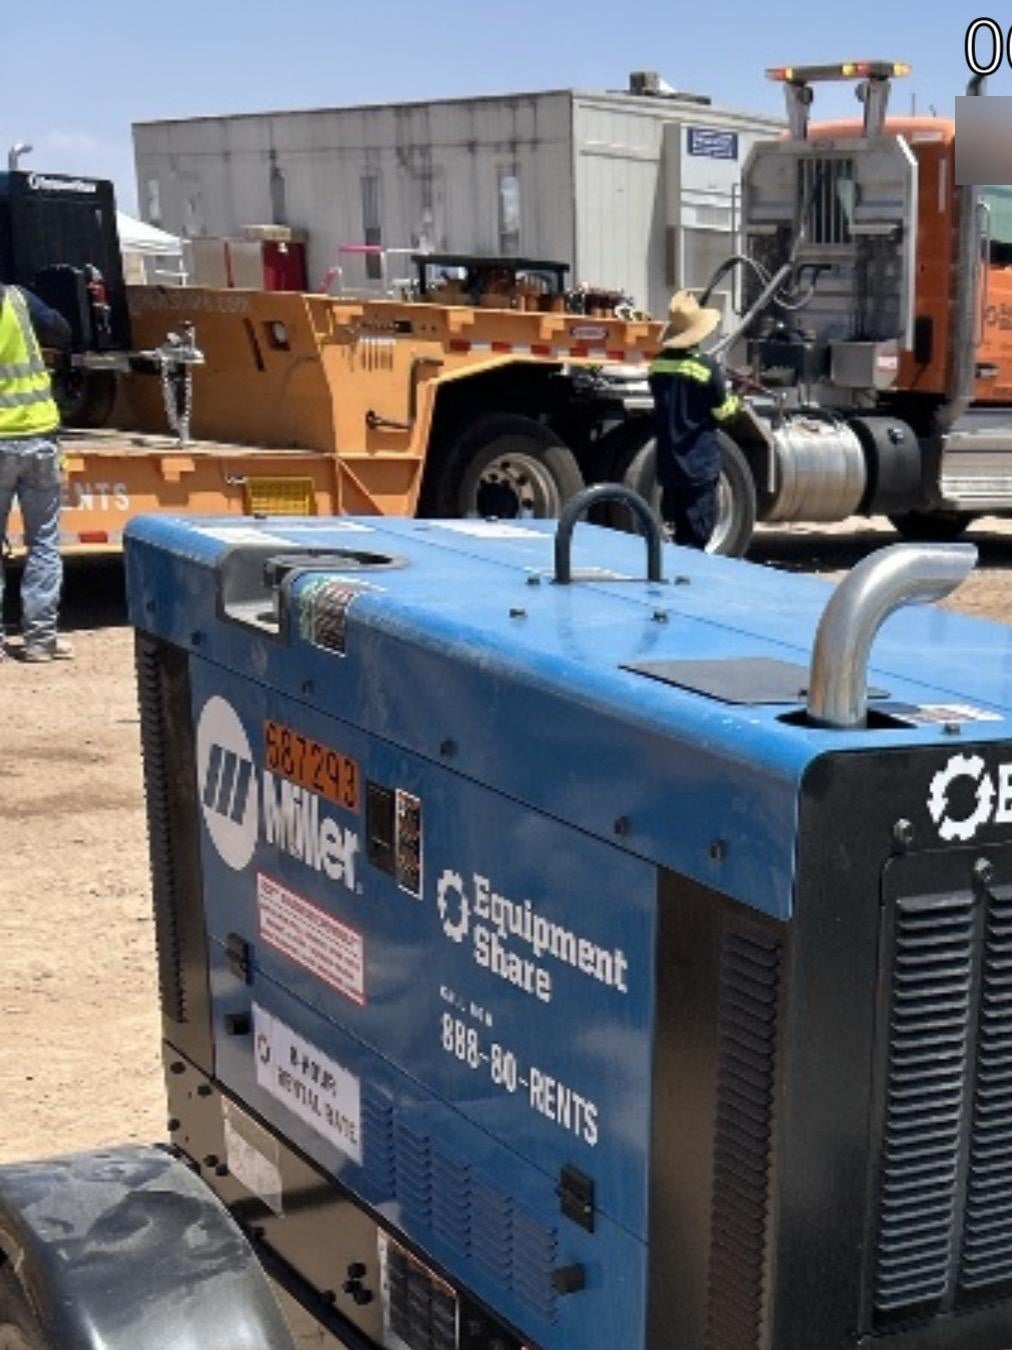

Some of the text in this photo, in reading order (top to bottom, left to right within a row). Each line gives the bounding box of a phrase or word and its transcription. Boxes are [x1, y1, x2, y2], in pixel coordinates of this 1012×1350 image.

[60, 481, 130, 512] ENTS
[263, 769, 359, 891] Miller
[472, 872, 629, 994] Equipment
[472, 924, 553, 1004] Share
[440, 1012, 599, 1147] 888-80-RENTS
